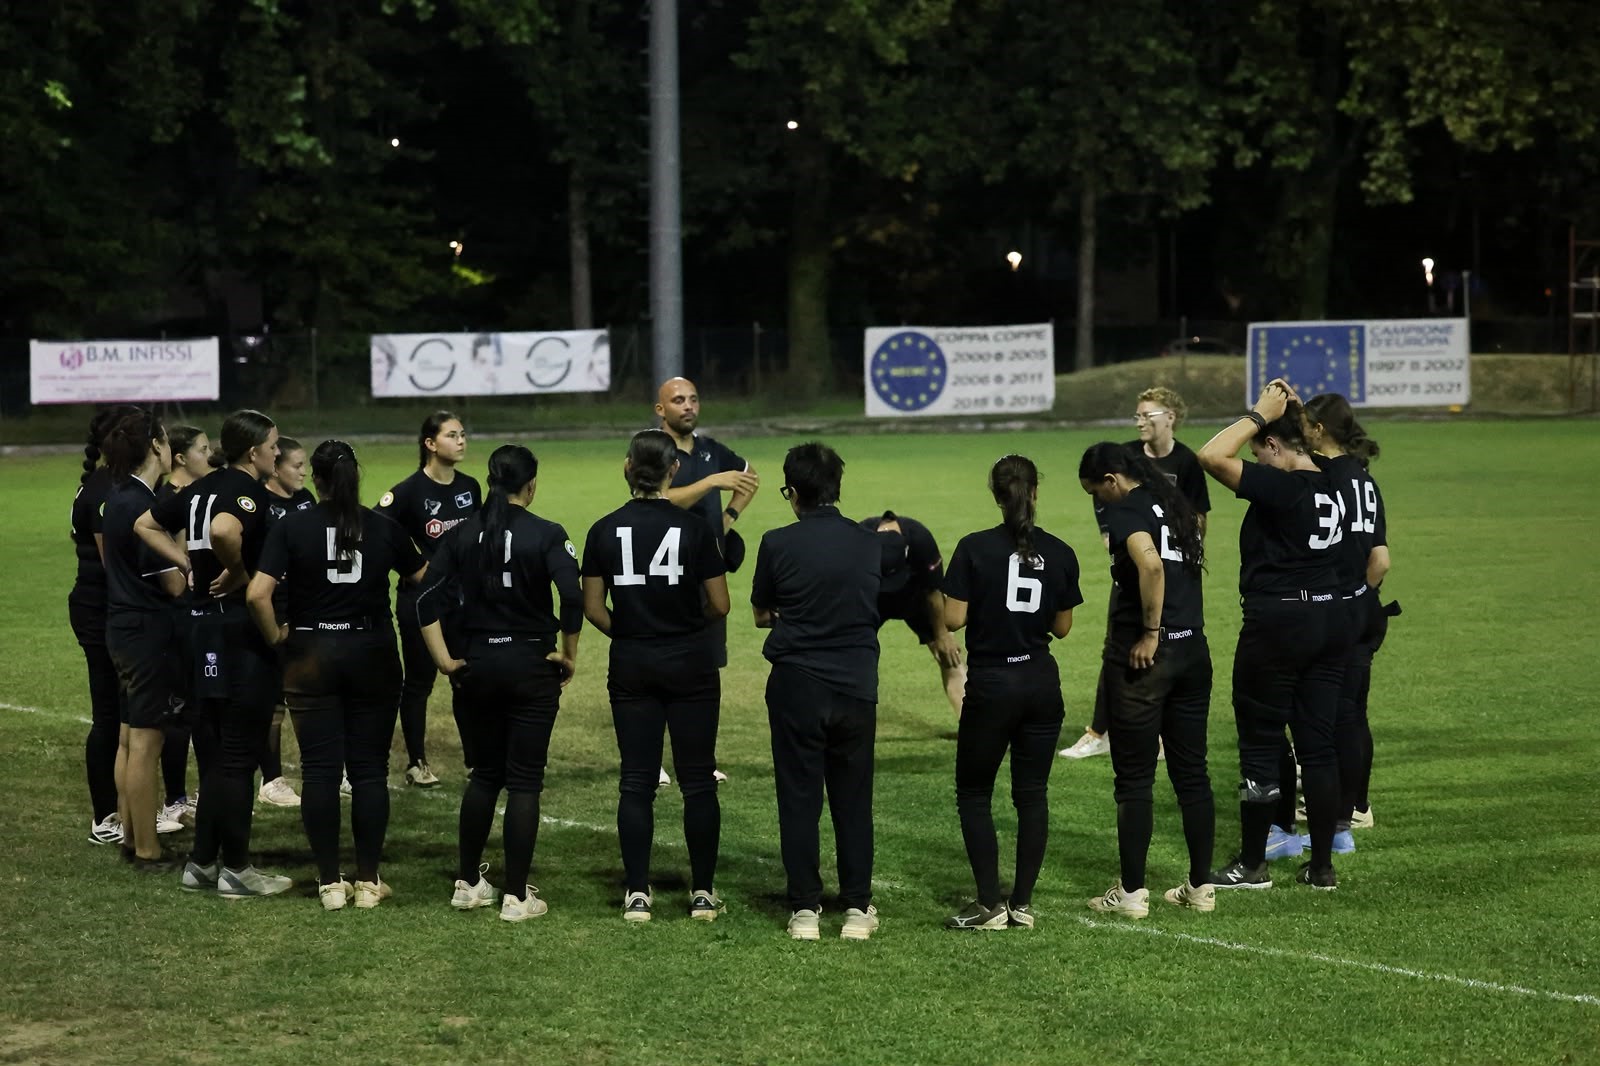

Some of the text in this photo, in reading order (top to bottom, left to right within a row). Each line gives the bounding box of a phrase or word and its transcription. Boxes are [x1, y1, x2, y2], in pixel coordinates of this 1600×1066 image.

[86, 344, 193, 362] B.M. INFISSI
[1351, 478, 1377, 534] 19
[326, 526, 363, 584] 5
[613, 526, 684, 586] 14
[1006, 551, 1045, 614] 6
[318, 622, 351, 631] macron
[1168, 628, 1193, 640] macron
[488, 636, 513, 644] macron
[1006, 654, 1031, 663] macron
